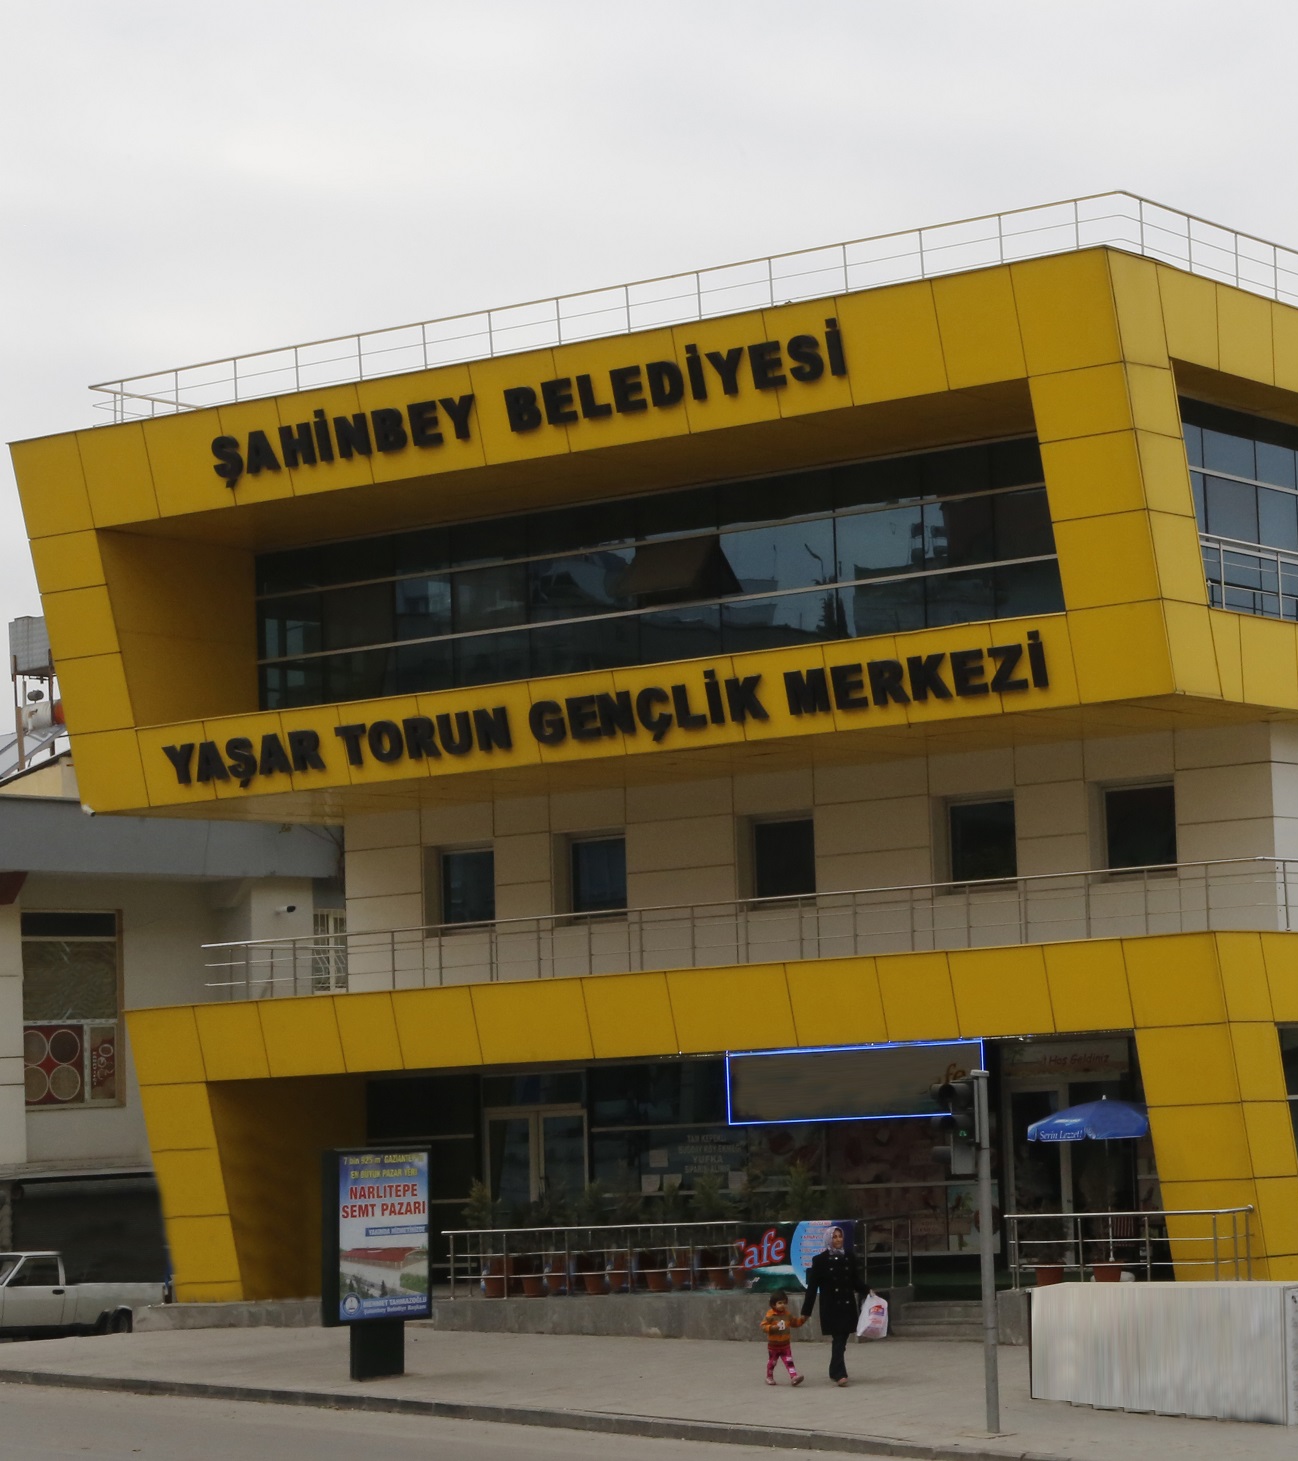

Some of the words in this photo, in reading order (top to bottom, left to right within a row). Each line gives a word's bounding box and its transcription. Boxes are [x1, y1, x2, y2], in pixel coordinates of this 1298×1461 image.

[212, 394, 475, 490] ŞAHİNBEY
[504, 318, 847, 433] BELEDİYESİ
[163, 731, 325, 788] YAŞAR
[335, 707, 512, 766] TORUN
[529, 669, 769, 746] GENÇLİK
[784, 631, 1049, 716] MERKEZİ
[1039, 1130, 1058, 1139] Serin
[349, 1183, 418, 1200] NARLITEPE
[341, 1203, 377, 1219] SEMT
[381, 1201, 426, 1217] PAZARI
